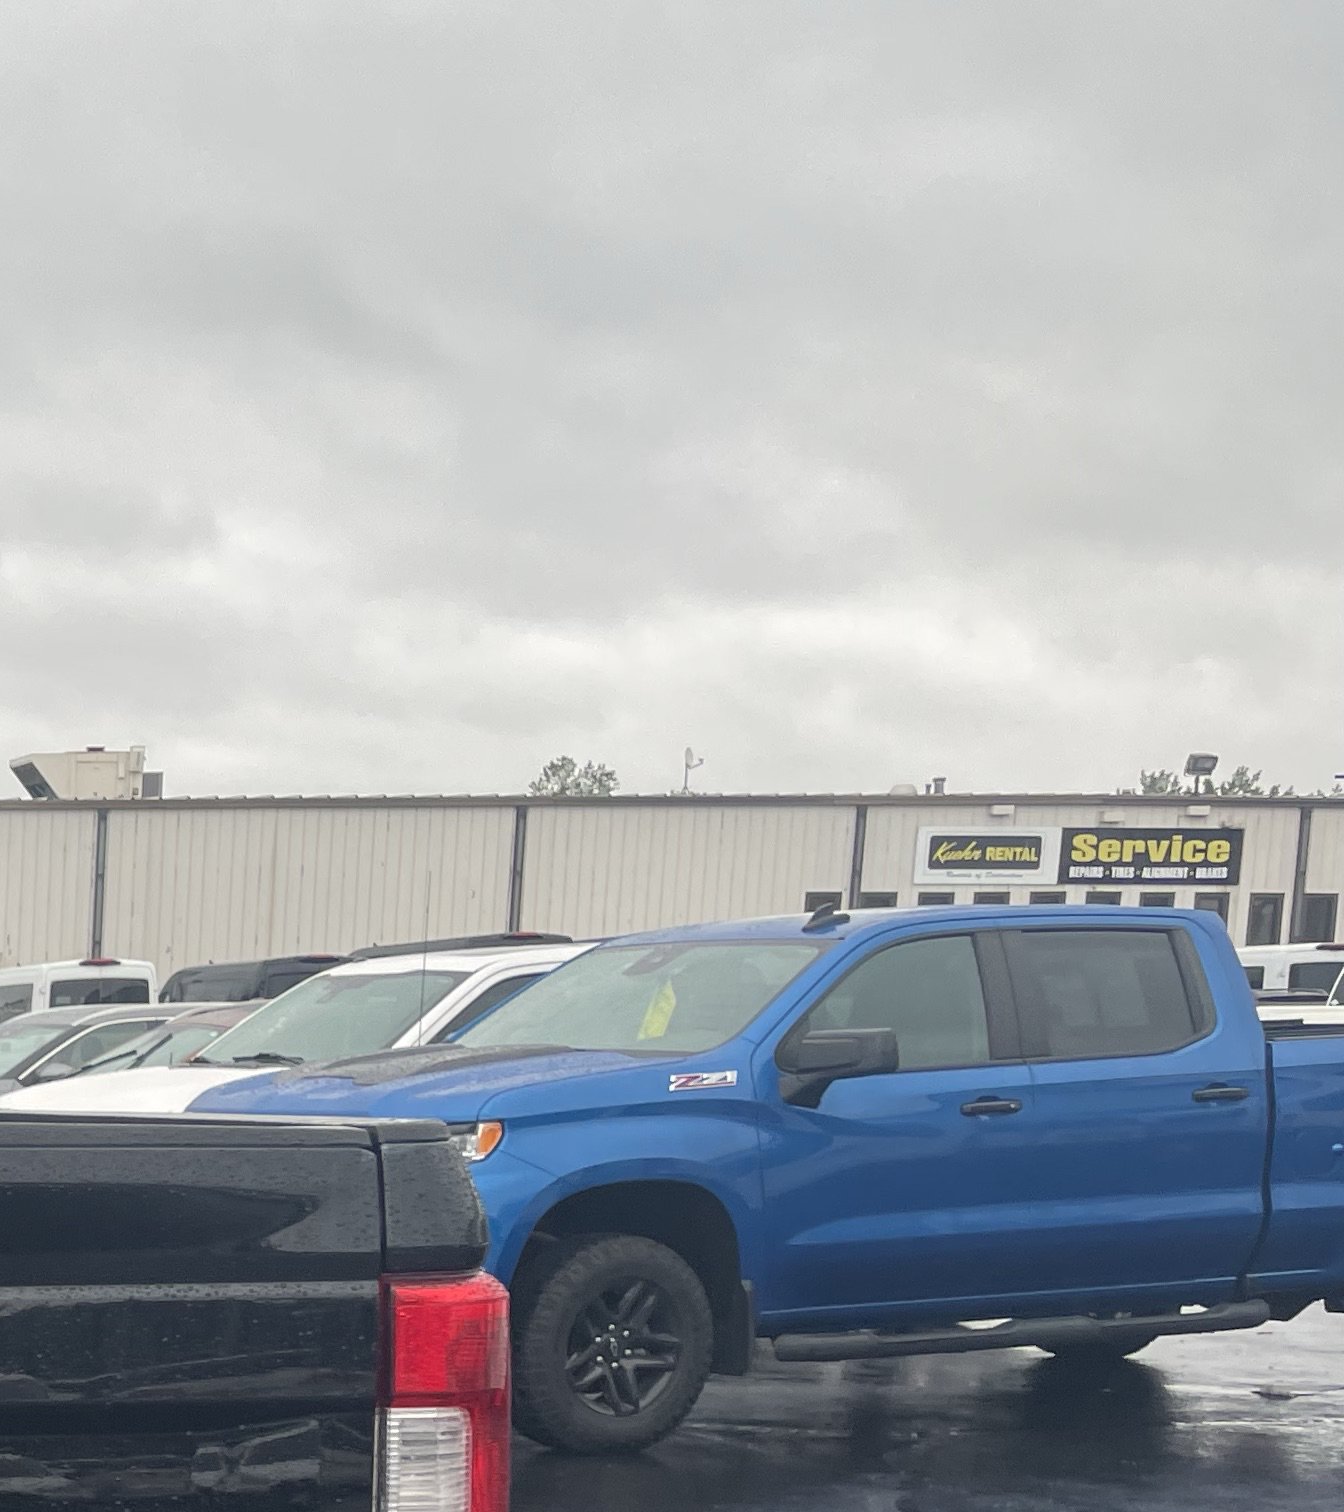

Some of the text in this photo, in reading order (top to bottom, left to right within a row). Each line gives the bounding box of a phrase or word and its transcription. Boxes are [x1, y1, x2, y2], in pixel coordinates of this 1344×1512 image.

[932, 841, 1039, 864] Kuehn RENTAL
[1071, 833, 1231, 863] Service
